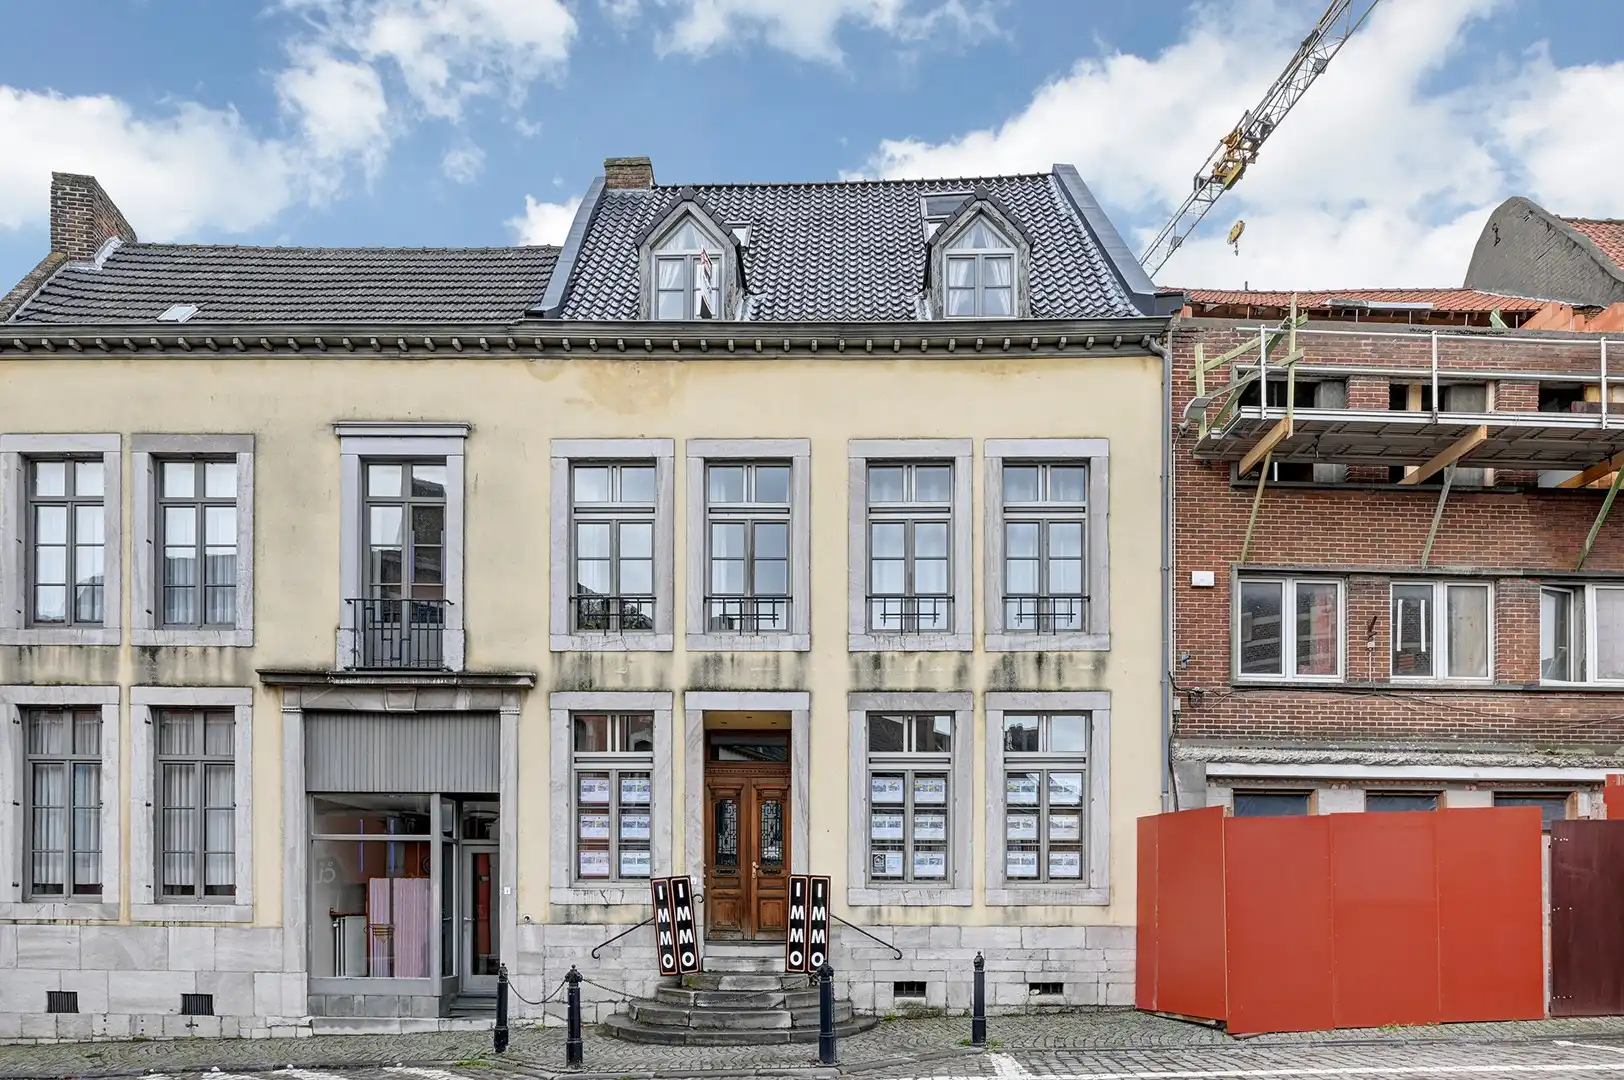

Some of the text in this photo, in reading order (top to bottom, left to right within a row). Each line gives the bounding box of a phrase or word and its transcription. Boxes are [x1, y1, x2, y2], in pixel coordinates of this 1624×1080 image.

[657, 885, 673, 969] IMMO
[676, 883, 695, 967] IMMO
[790, 882, 805, 966] IMMO
[811, 883, 826, 967] IMMO
